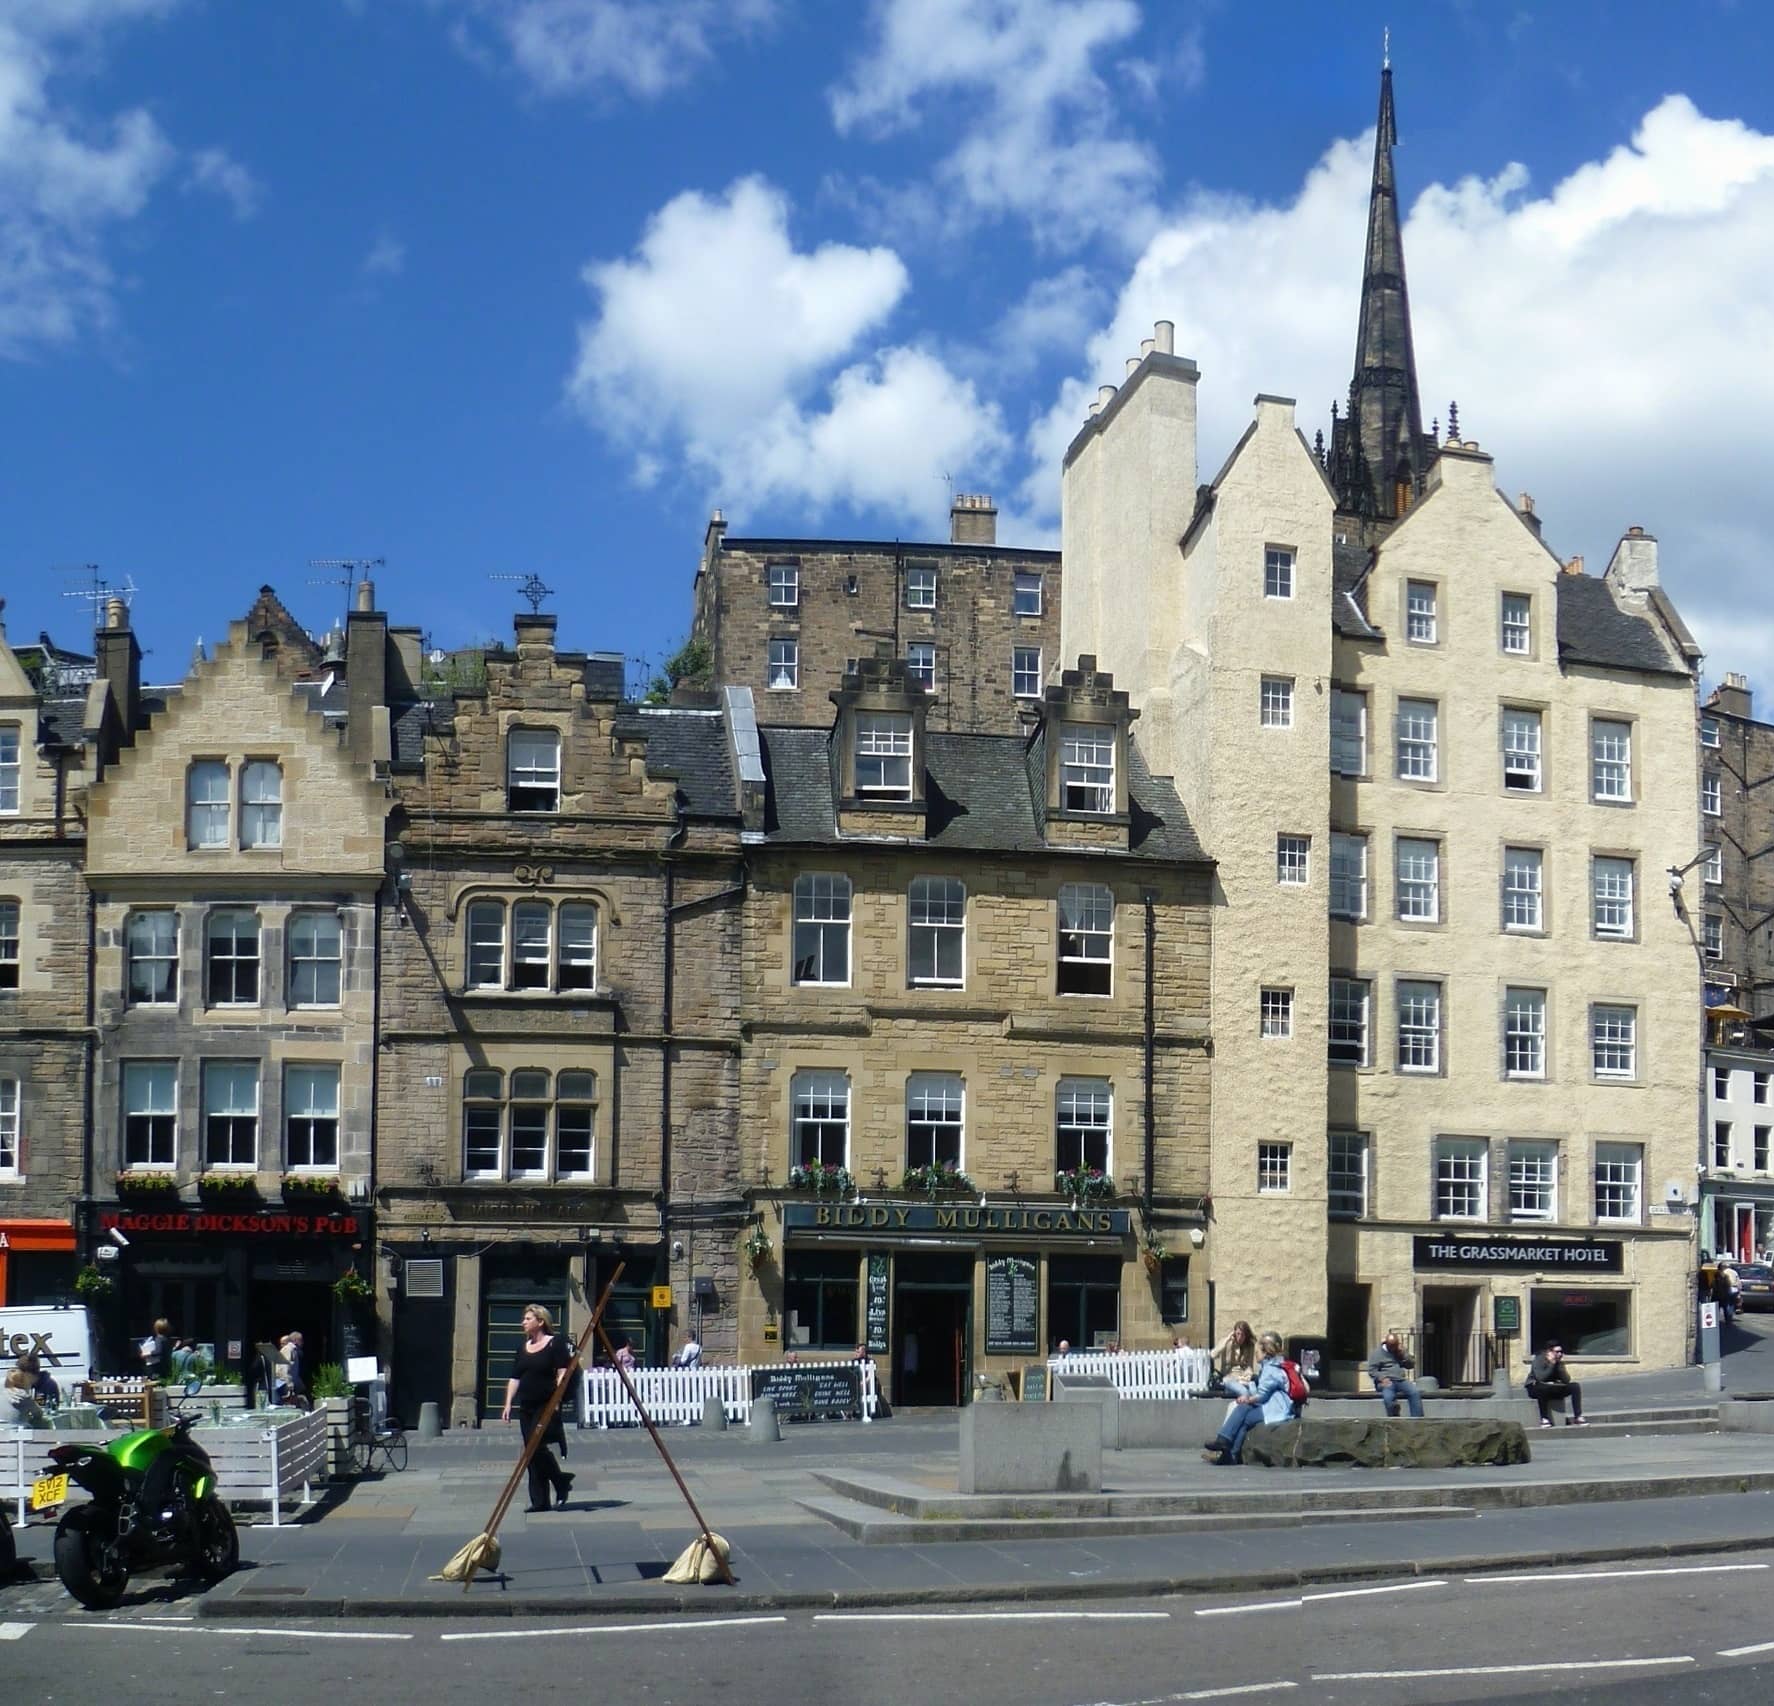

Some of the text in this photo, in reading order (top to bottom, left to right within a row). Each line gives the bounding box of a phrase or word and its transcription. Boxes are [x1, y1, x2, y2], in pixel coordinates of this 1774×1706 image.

[100, 1214, 358, 1233] MAGGIE DICKSON'S PUB
[816, 1206, 1112, 1231] BIDDY MULLIGANS
[1429, 1245, 1608, 1262] THE GRASSMARKET HOTEL
[38, 1476, 63, 1492] SV12
[39, 1488, 60, 1504] XCF
